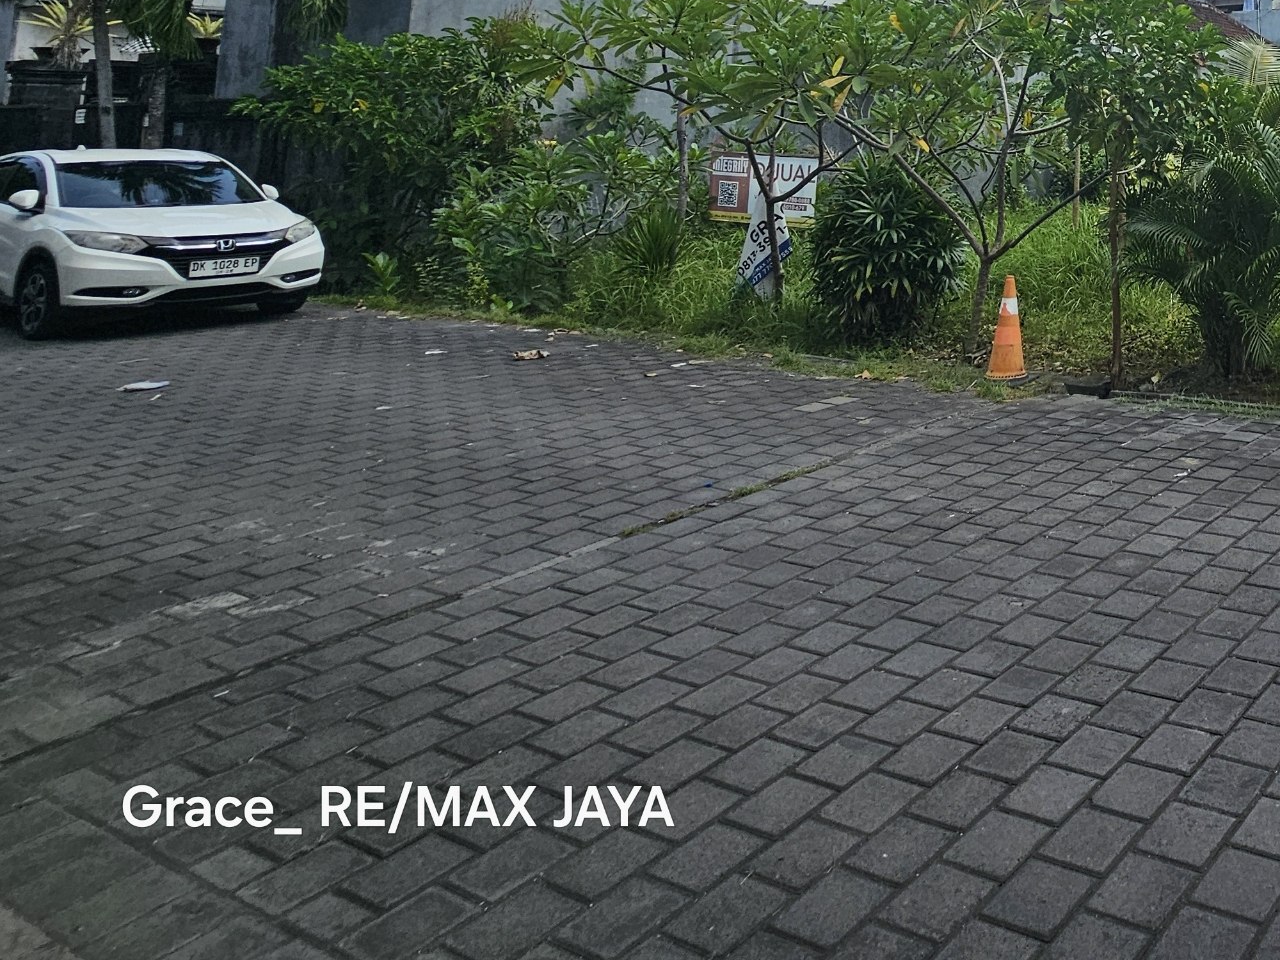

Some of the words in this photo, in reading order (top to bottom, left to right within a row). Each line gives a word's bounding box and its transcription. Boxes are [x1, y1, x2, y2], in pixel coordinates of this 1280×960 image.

[191, 262, 206, 272] DK
[212, 259, 240, 271] 1028
[243, 257, 258, 268] EP
